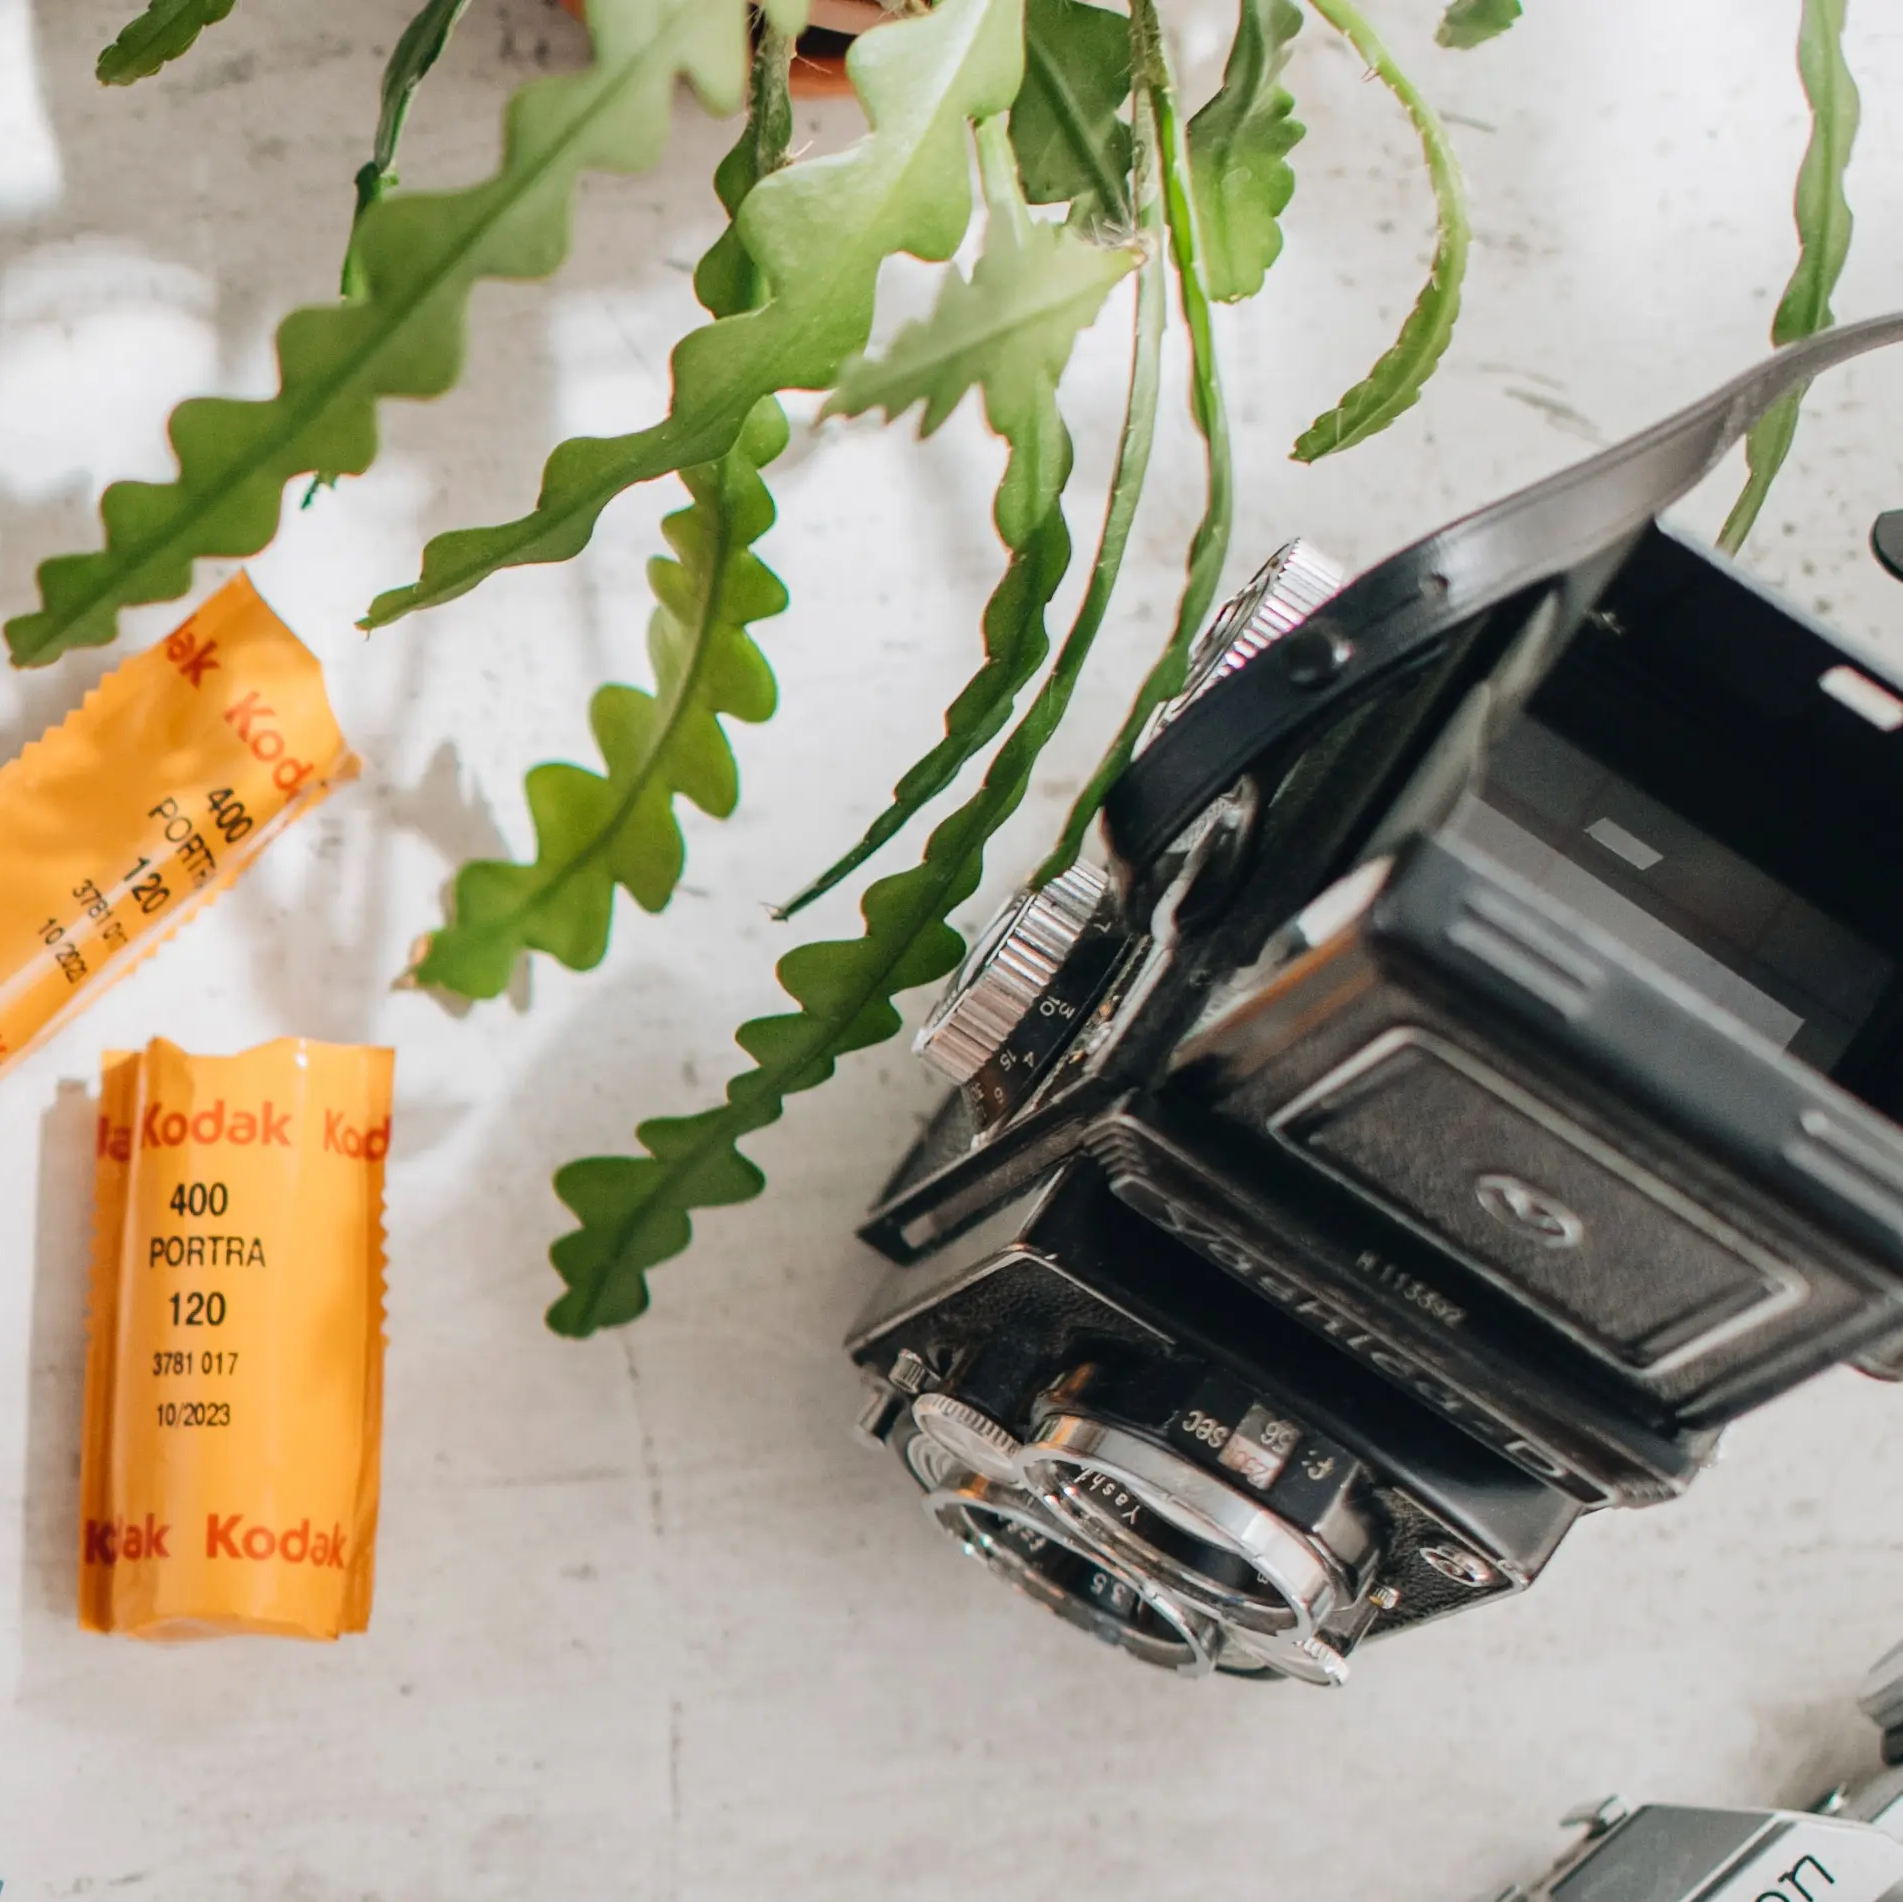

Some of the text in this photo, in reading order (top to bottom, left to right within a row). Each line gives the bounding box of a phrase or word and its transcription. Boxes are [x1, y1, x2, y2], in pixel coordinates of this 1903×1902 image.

[223, 690, 316, 804] Kod
[207, 787, 254, 845] 400
[122, 857, 171, 915] 120
[169, 1181, 230, 1217] 400
[149, 1235, 267, 1268] PORTRA
[168, 1291, 227, 1328] 120
[151, 1351, 239, 1376] 3781 017
[156, 1402, 232, 1429] 10/2023
[206, 1514, 348, 1569] Kodak
